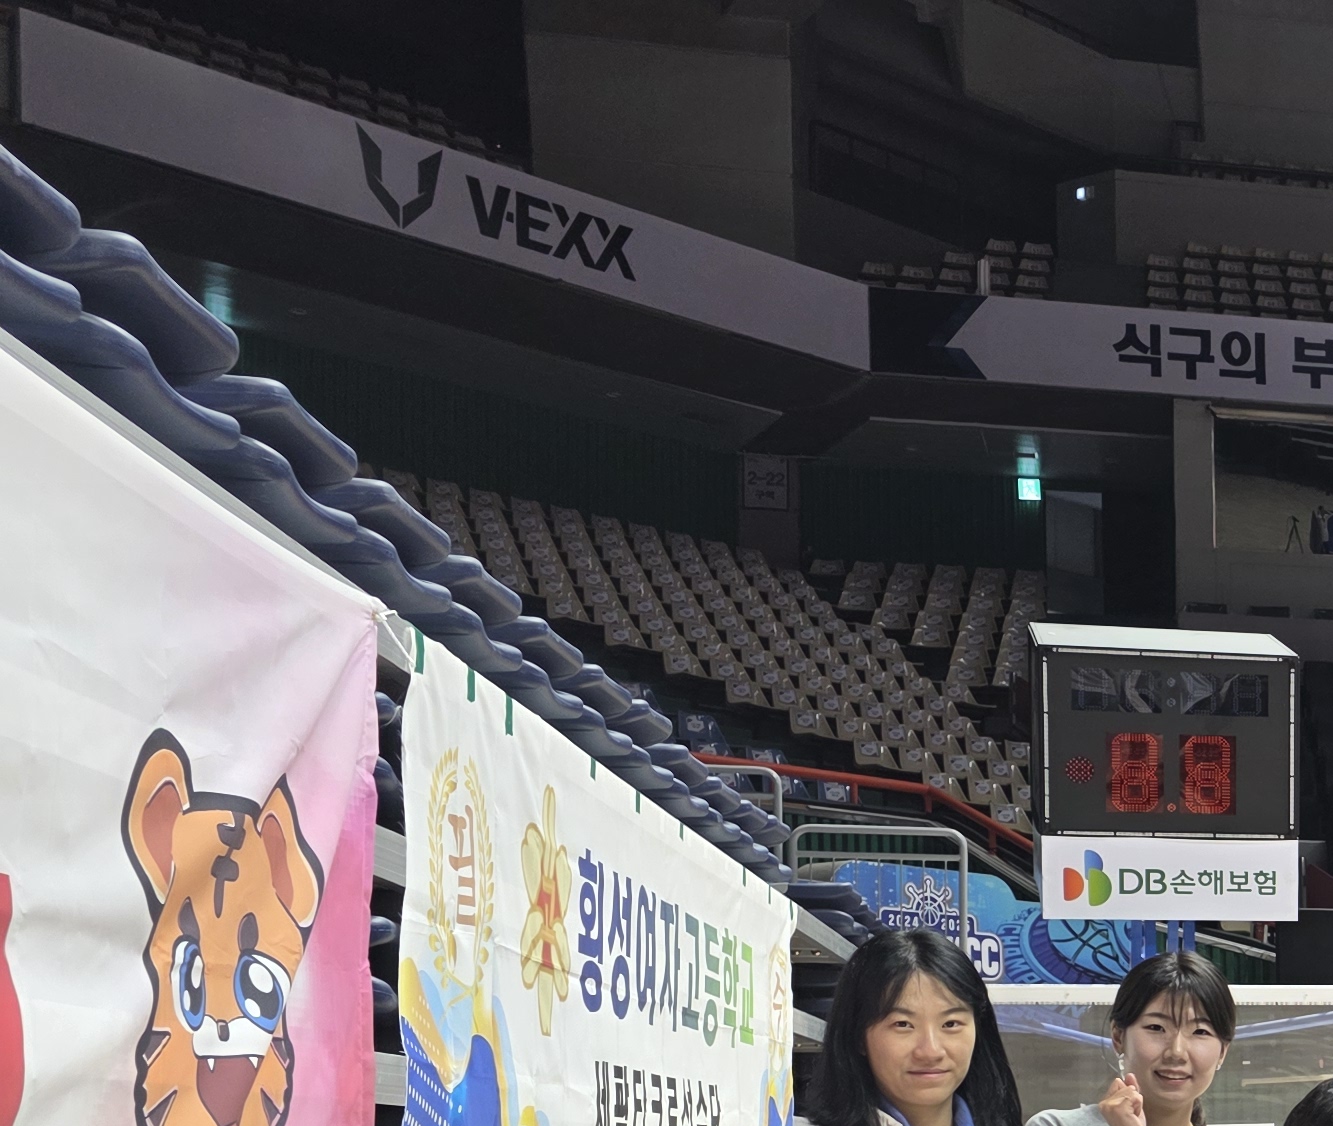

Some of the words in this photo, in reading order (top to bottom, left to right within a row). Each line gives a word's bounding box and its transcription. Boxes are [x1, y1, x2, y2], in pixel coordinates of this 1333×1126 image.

[1112, 323, 1267, 385] 식구의
[1118, 868, 1278, 896] DB손해보험
[577, 848, 755, 1050] 횡성여자고등학교
